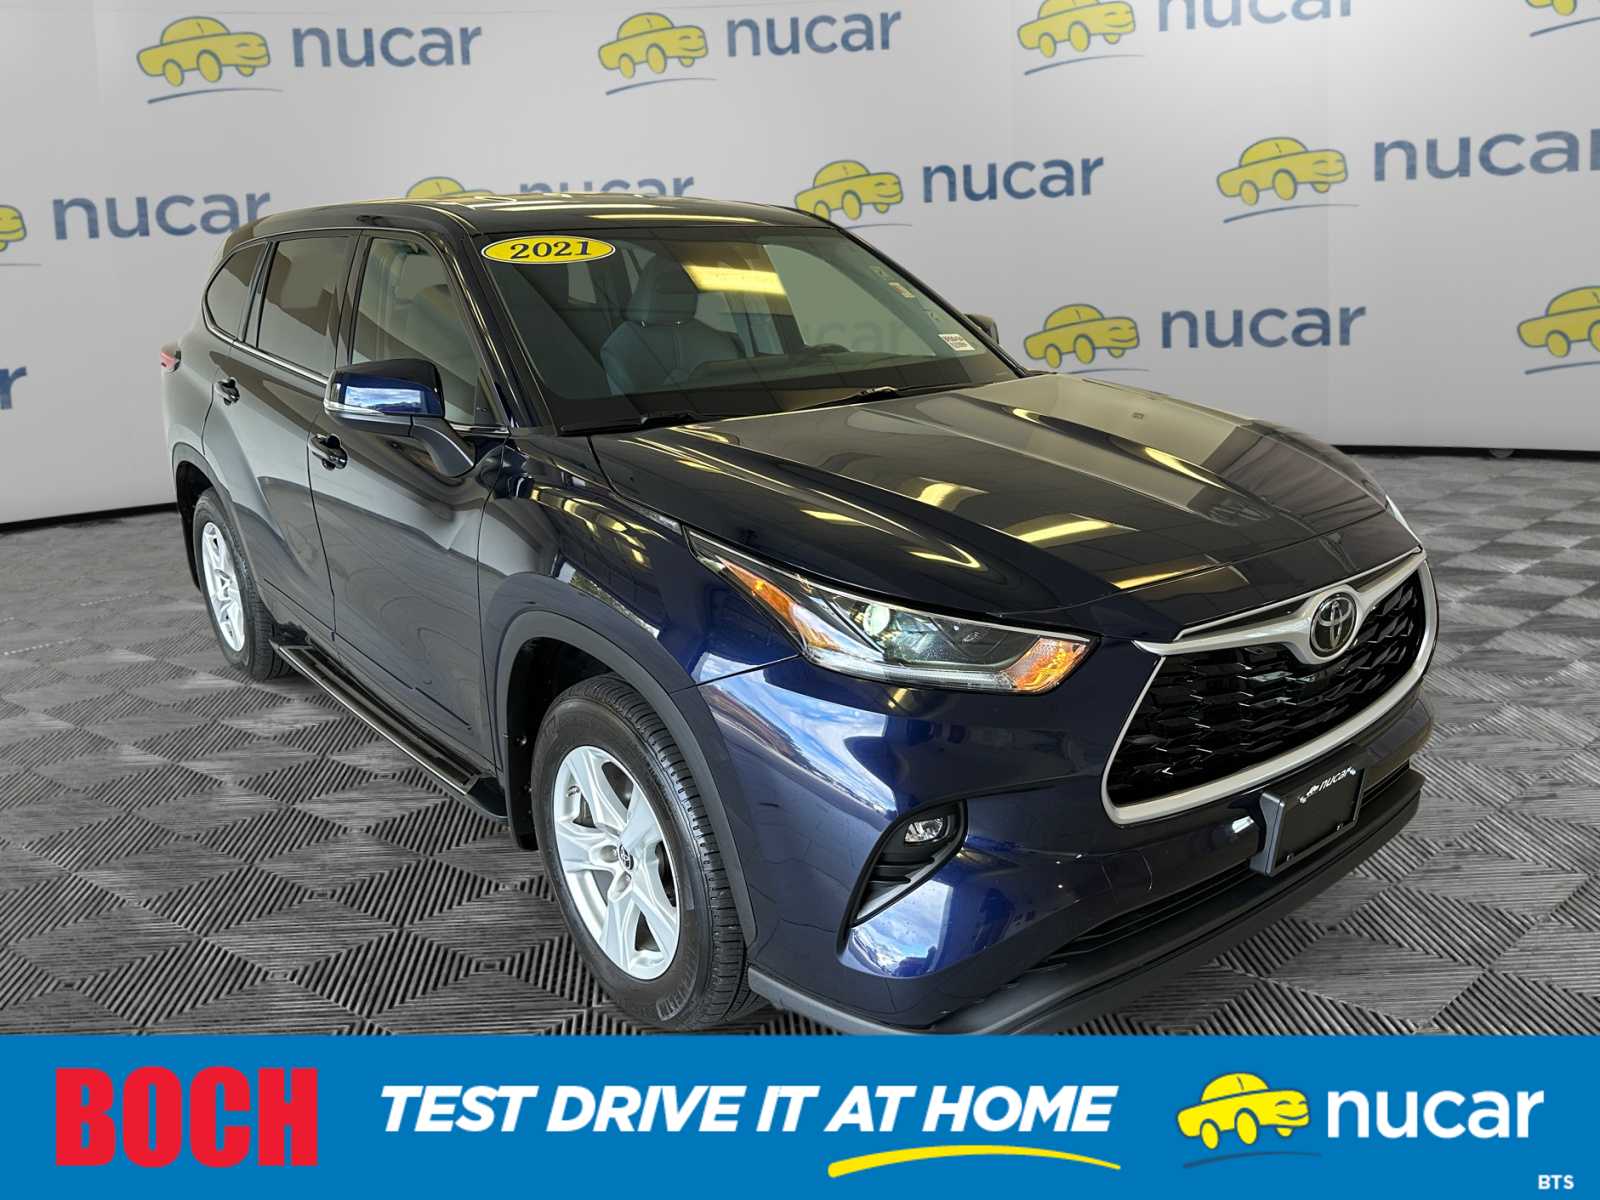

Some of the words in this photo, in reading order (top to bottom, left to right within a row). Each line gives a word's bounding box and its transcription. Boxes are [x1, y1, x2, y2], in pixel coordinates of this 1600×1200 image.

[292, 26, 481, 67] nucar
[727, 11, 901, 57] nucar
[922, 157, 1104, 203] nucar
[52, 192, 271, 240] nucar
[510, 241, 591, 259] 2021
[1161, 304, 1366, 351] nucar
[1318, 766, 1352, 792] nucar
